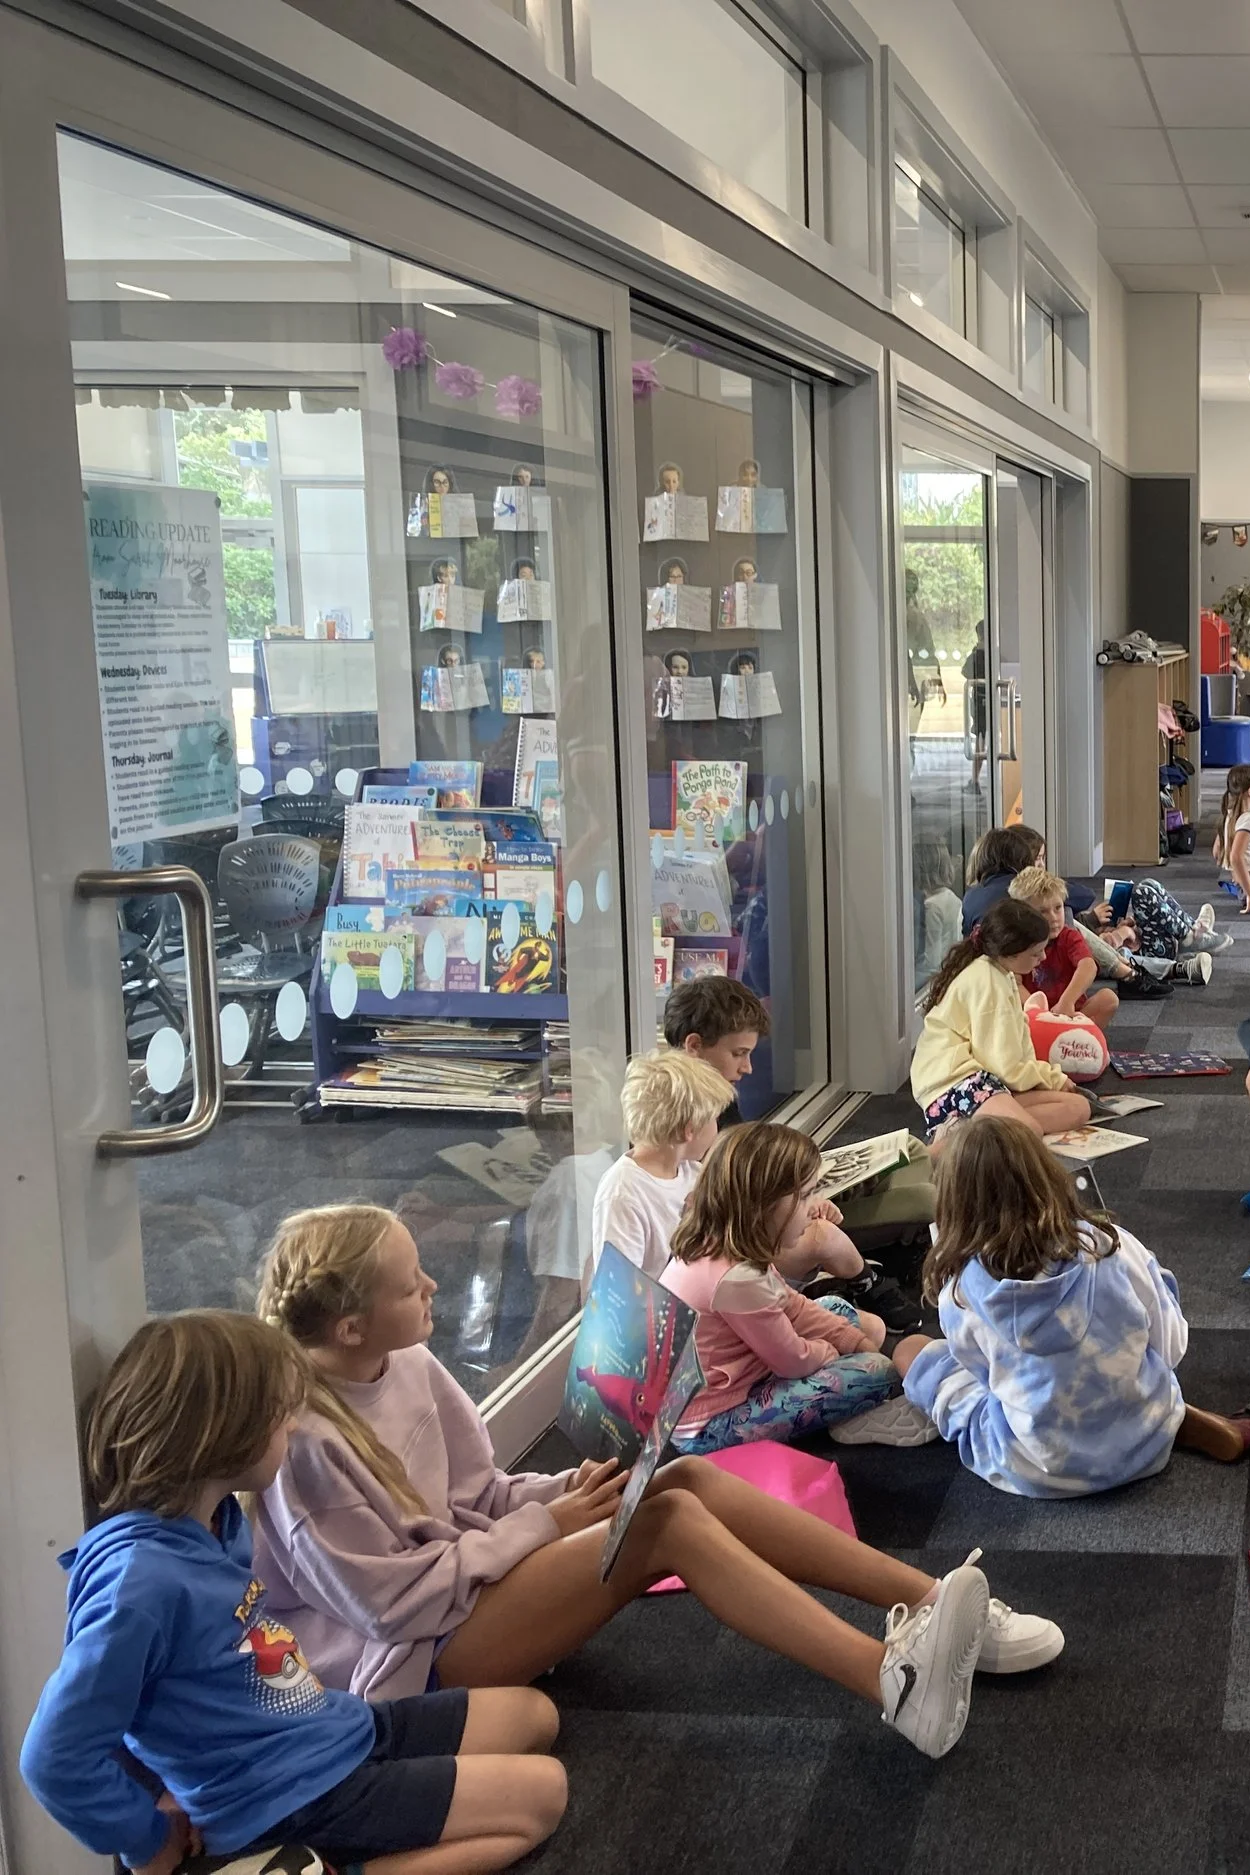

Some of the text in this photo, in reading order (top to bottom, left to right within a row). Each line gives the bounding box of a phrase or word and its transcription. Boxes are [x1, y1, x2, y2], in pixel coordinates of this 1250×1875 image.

[89, 517, 211, 543] READING UPDATE
[131, 588, 157, 603] Library
[101, 664, 167, 680] Wednesday: Devices
[537, 727, 550, 736] The
[112, 748, 173, 767] Thursday: Journal
[683, 764, 731, 781] The Path to
[683, 776, 738, 796] Ponga Pond
[357, 811, 371, 819] The
[355, 822, 409, 835] ADVENTURE
[421, 824, 480, 837] The Cheese
[440, 837, 464, 849] Trap
[498, 853, 551, 863] Manga Boys
[336, 912, 359, 931] Busy
[488, 926, 533, 941] AWME
[328, 938, 406, 949] The Little Tuatara
